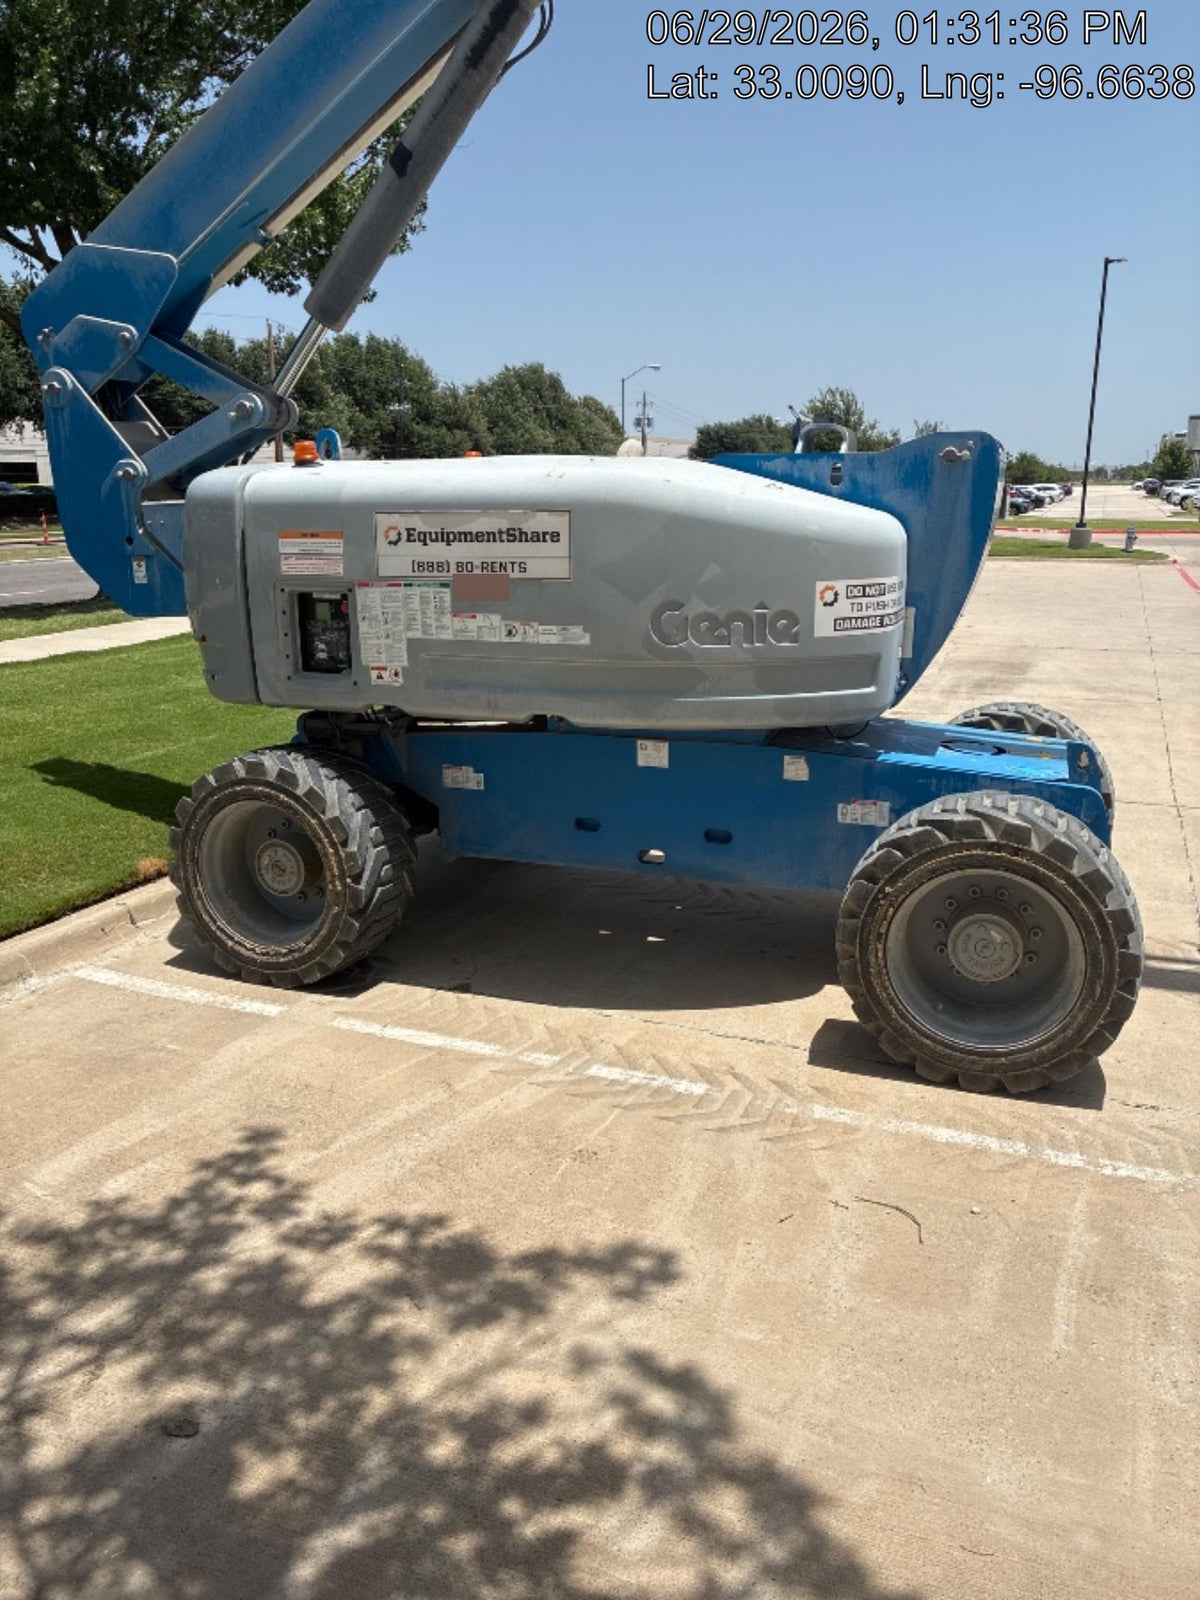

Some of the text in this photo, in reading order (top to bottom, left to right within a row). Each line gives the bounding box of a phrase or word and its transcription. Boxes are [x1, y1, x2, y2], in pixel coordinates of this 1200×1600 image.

[405, 527, 561, 546] EquipmentShare
[412, 560, 527, 573] (888) 80-RENTS
[847, 585, 863, 597] DO
[865, 583, 886, 597] NOT
[850, 602, 863, 612] TO
[649, 600, 800, 648] Genie
[835, 616, 882, 630] DAMAGE
